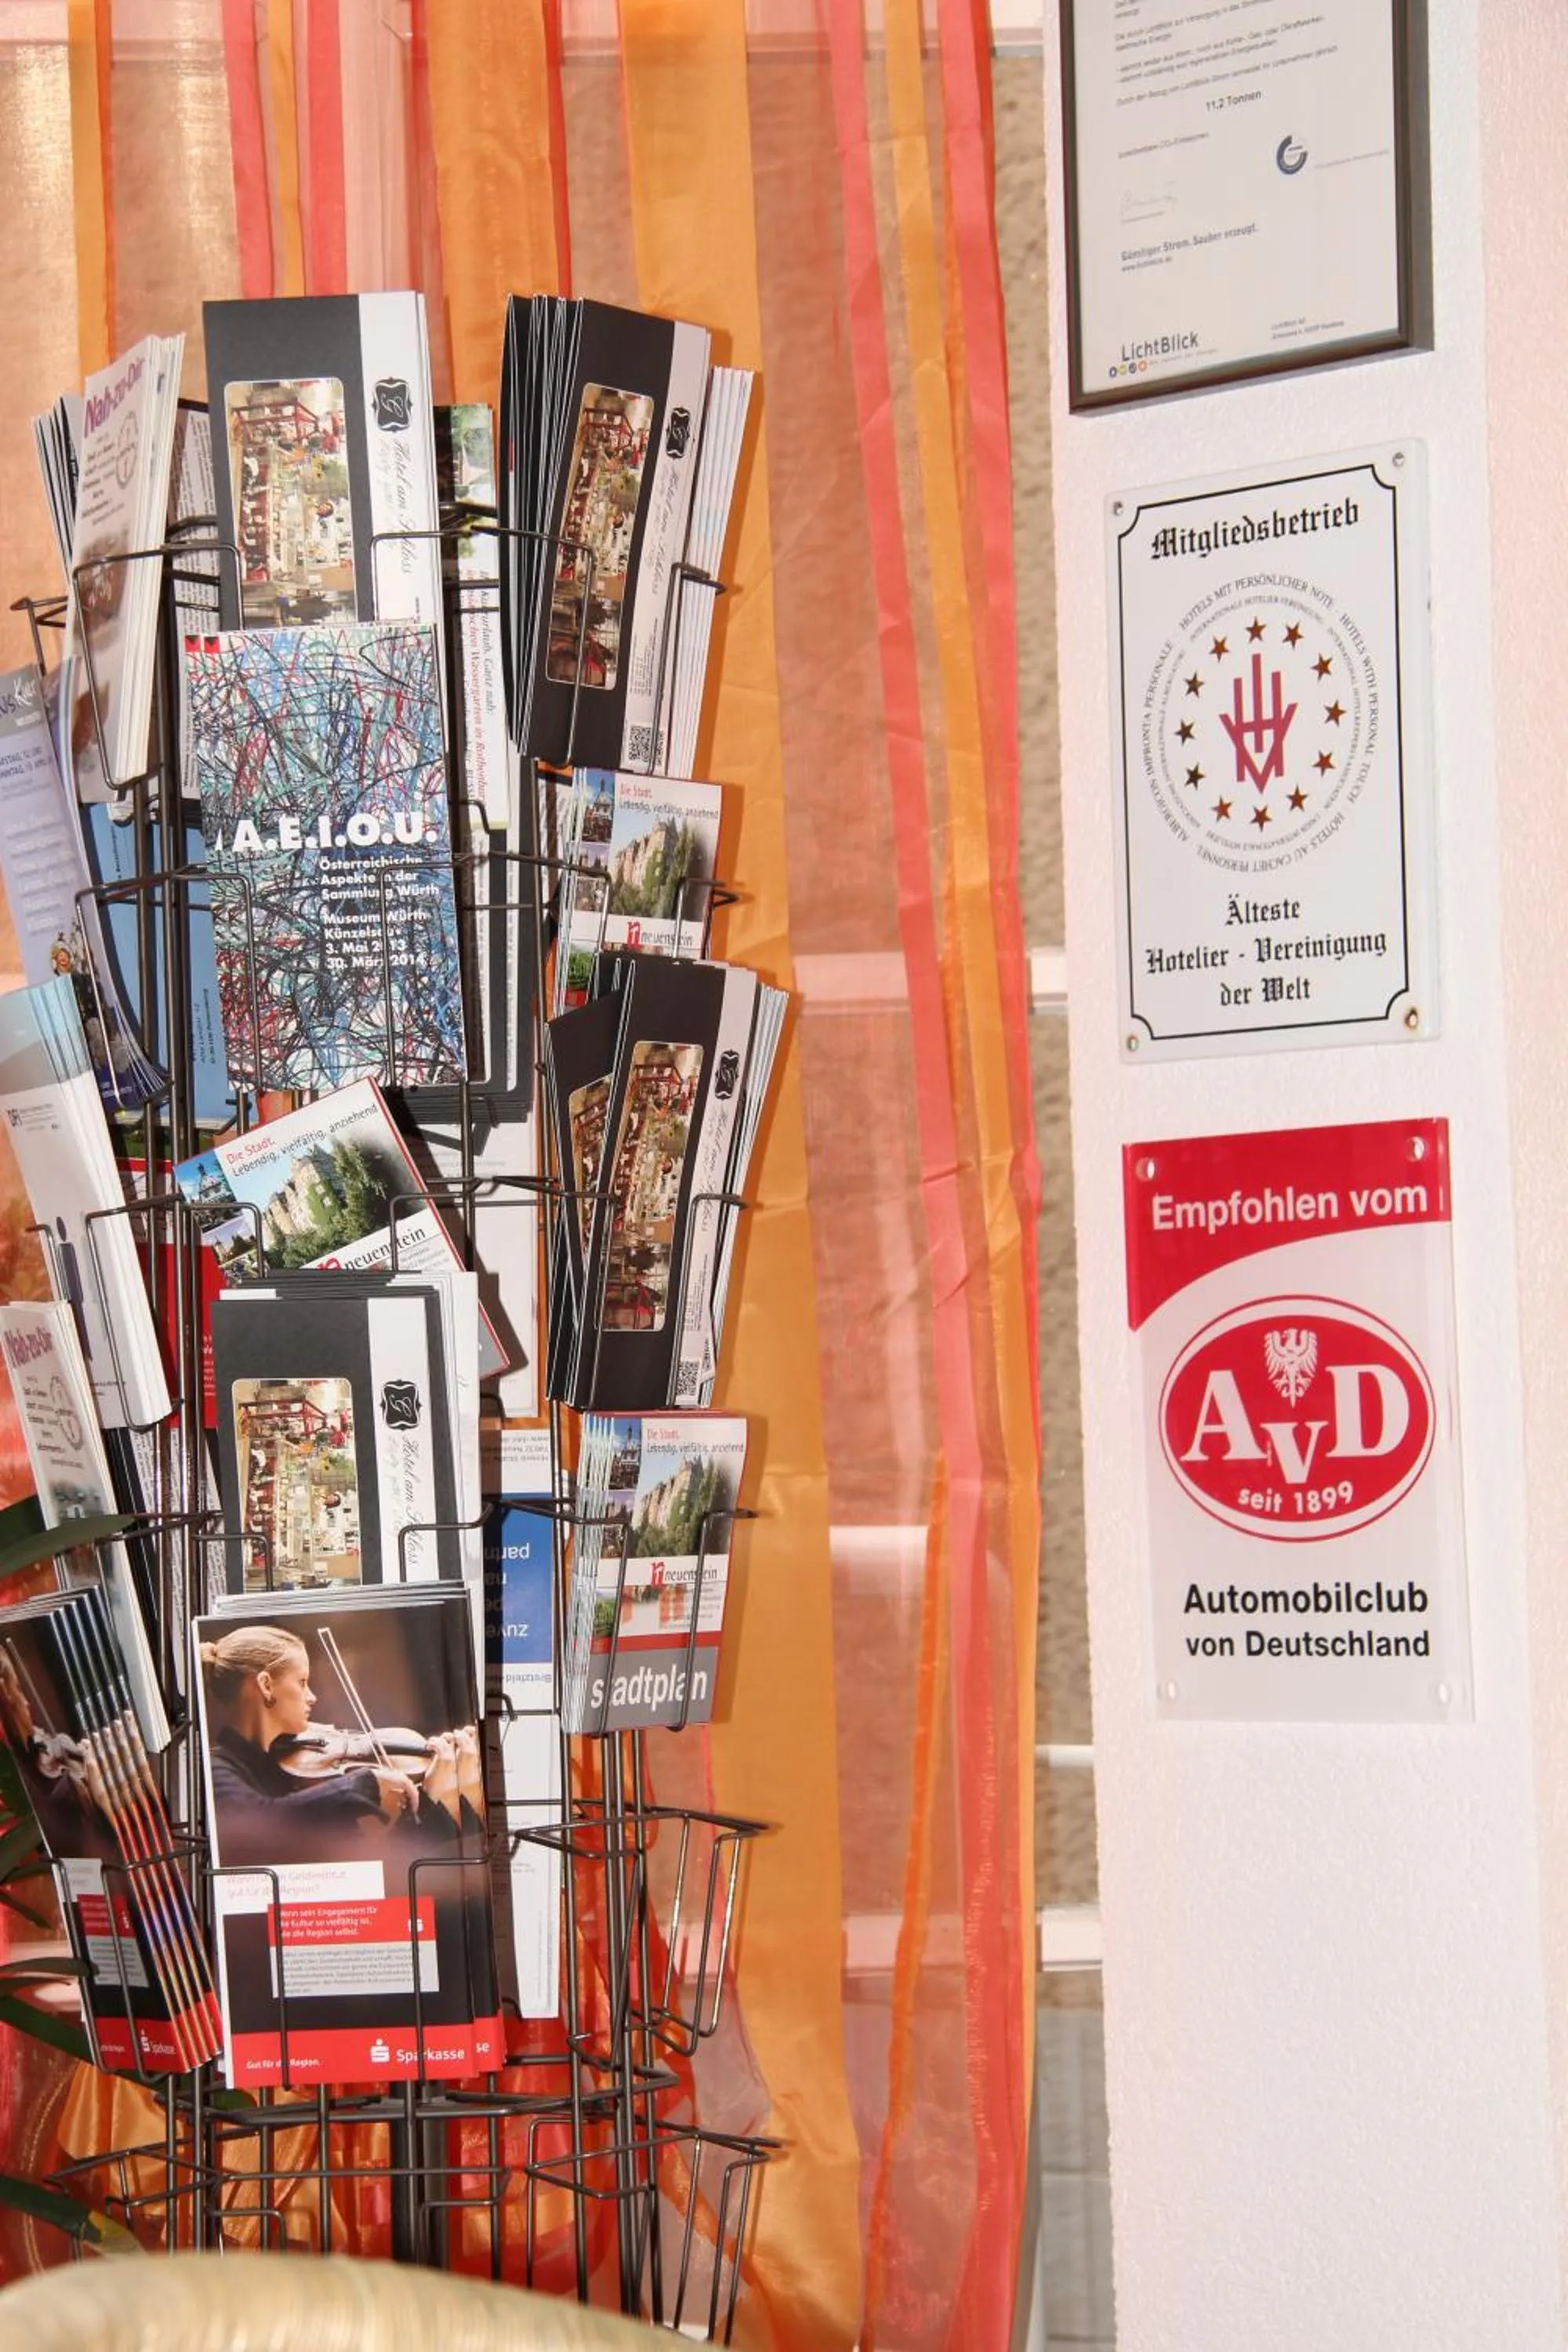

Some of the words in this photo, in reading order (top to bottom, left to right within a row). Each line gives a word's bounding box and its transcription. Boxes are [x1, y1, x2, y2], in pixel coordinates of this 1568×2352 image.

[1227, 89, 1261, 107] Tonnen
[1122, 331, 1199, 361] LichtBlick
[396, 508, 416, 575] Shloss
[1150, 497, 1359, 559] Mitgliedsbetrieb
[475, 742, 488, 801] Rothenbur
[232, 812, 437, 852] A.E.I.O.U.
[321, 873, 376, 887] Aspekte
[395, 871, 419, 882] der
[397, 884, 440, 896] Würth
[324, 911, 381, 924] Museum
[1225, 892, 1300, 927] Älteste
[326, 943, 338, 954] 3.
[343, 942, 368, 953] Mai
[372, 941, 406, 953] 213
[327, 957, 349, 970] 30.
[353, 956, 384, 968] Mär
[1145, 943, 1230, 974] Hotelier
[1254, 930, 1387, 964] Vereinigung
[1219, 979, 1252, 1007] der
[1261, 976, 1311, 1004] Welt
[226, 1150, 245, 1164] Die
[244, 1137, 274, 1156] Stadt.
[232, 1151, 280, 1177] Lebendig,
[328, 1103, 378, 1133] anziehend
[1152, 1187, 1338, 1236] Empfohlen
[1350, 1185, 1428, 1217] vom
[344, 1228, 426, 1271] neuentein
[647, 1428, 658, 1439] Die
[1238, 1486, 1283, 1513] seit
[1294, 1481, 1355, 1514] 1899
[405, 1505, 426, 1568] Shloss
[1183, 1581, 1428, 1615] Automobilclub
[1185, 1633, 1235, 1658] von
[1245, 1630, 1431, 1658] Deutschland
